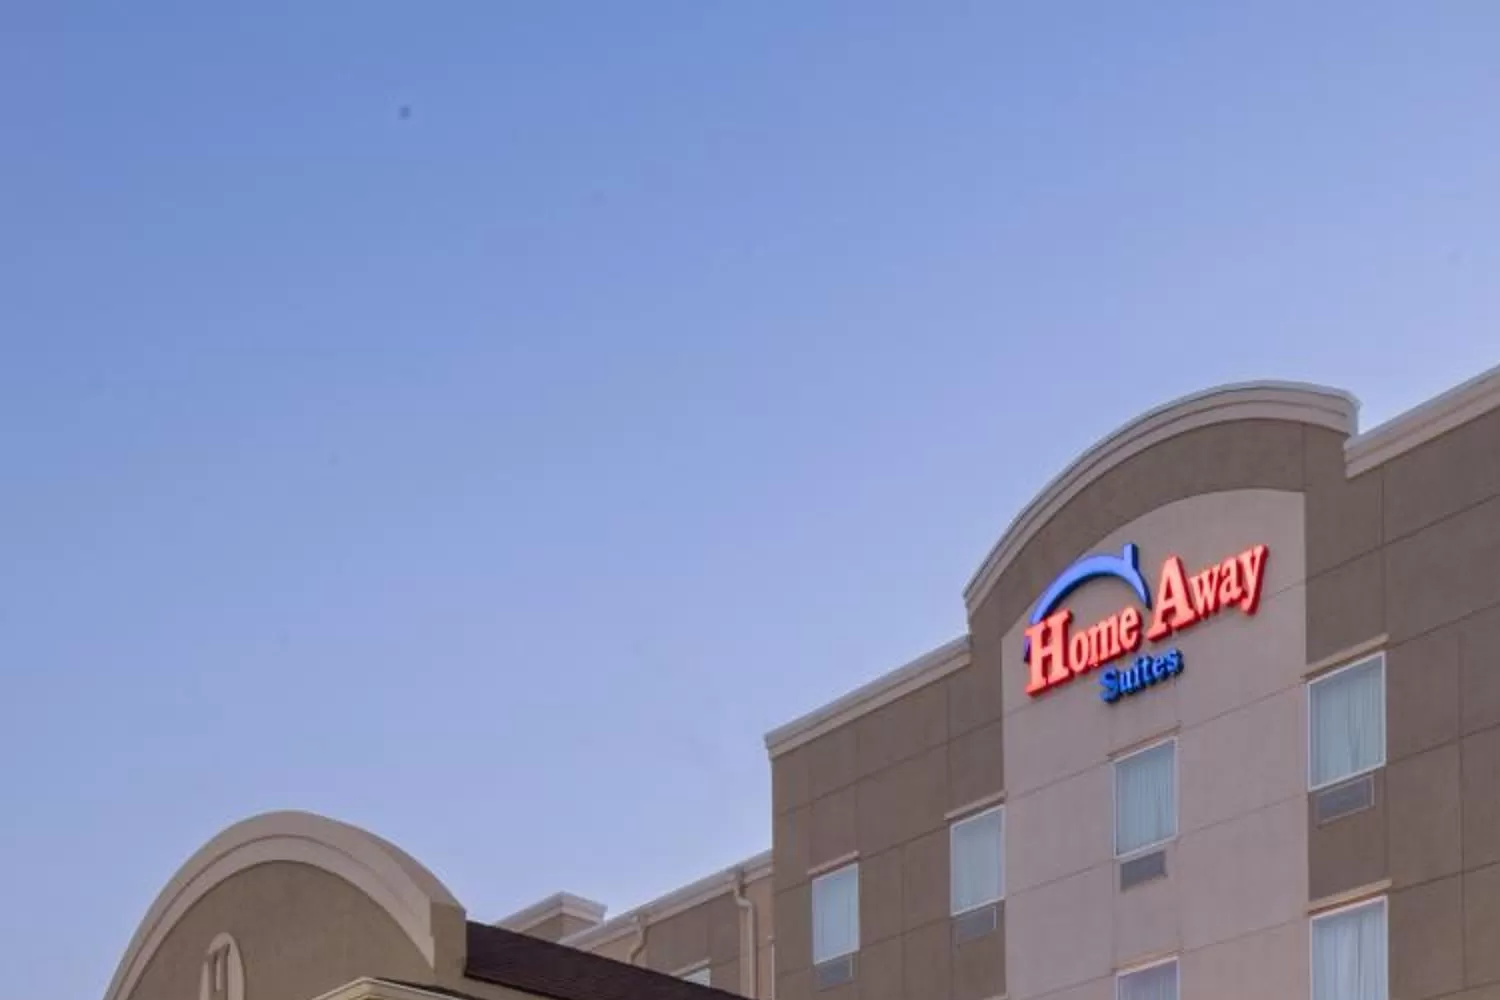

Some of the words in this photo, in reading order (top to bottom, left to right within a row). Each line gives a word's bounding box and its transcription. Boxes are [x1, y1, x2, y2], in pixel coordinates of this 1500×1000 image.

[1024, 607, 1143, 697] Home
[1147, 544, 1269, 642] Away
[1099, 647, 1185, 703] Suites
